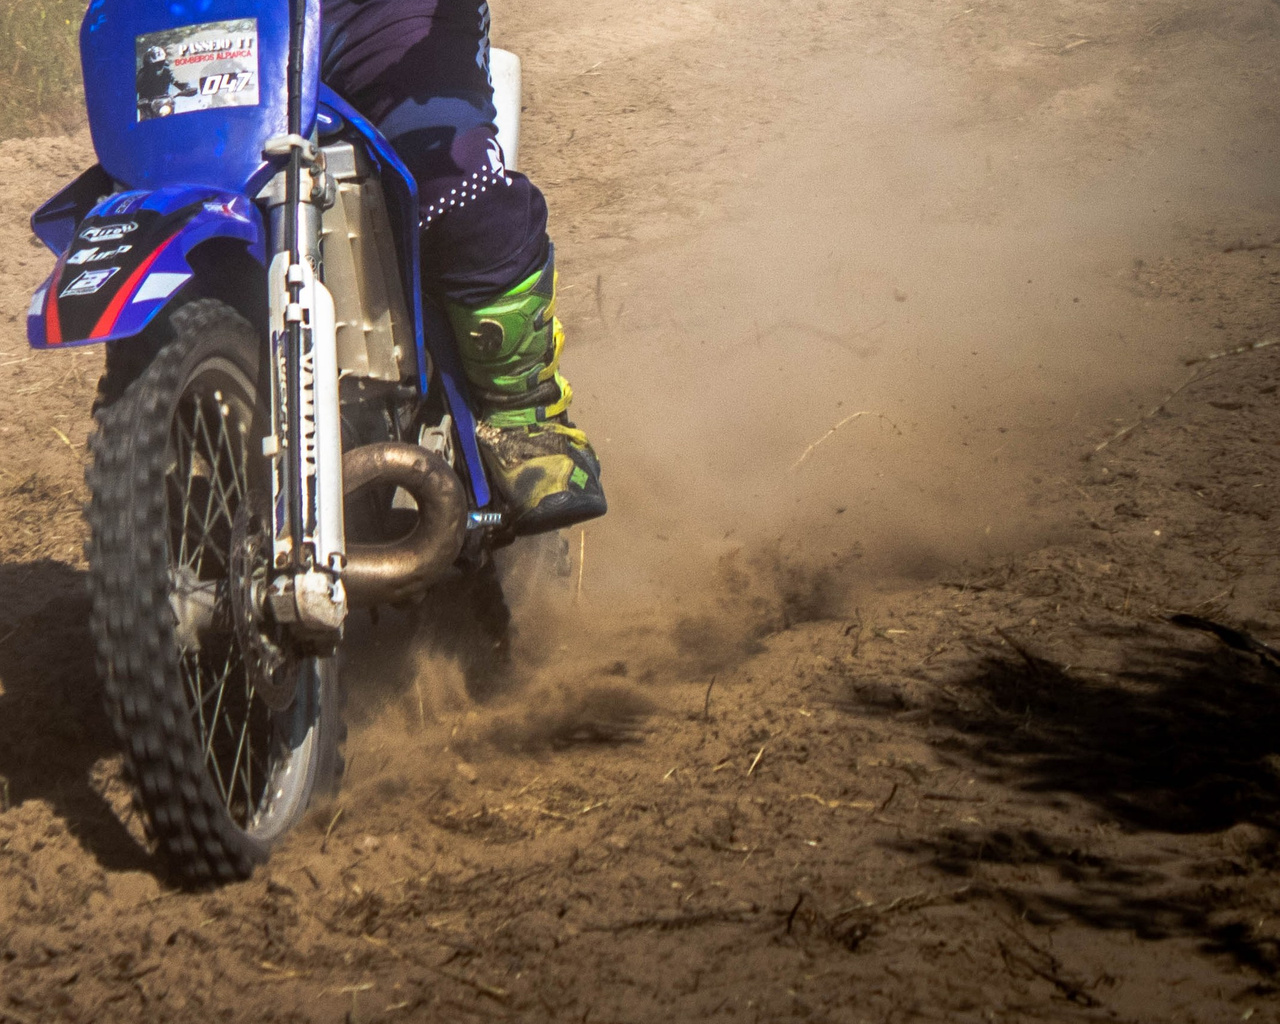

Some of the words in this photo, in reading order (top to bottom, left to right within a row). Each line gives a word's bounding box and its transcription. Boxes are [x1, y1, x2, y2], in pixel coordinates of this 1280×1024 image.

[178, 38, 232, 57] PASSEIO
[174, 53, 215, 67] BOMBEIROS
[201, 71, 254, 95] 047
